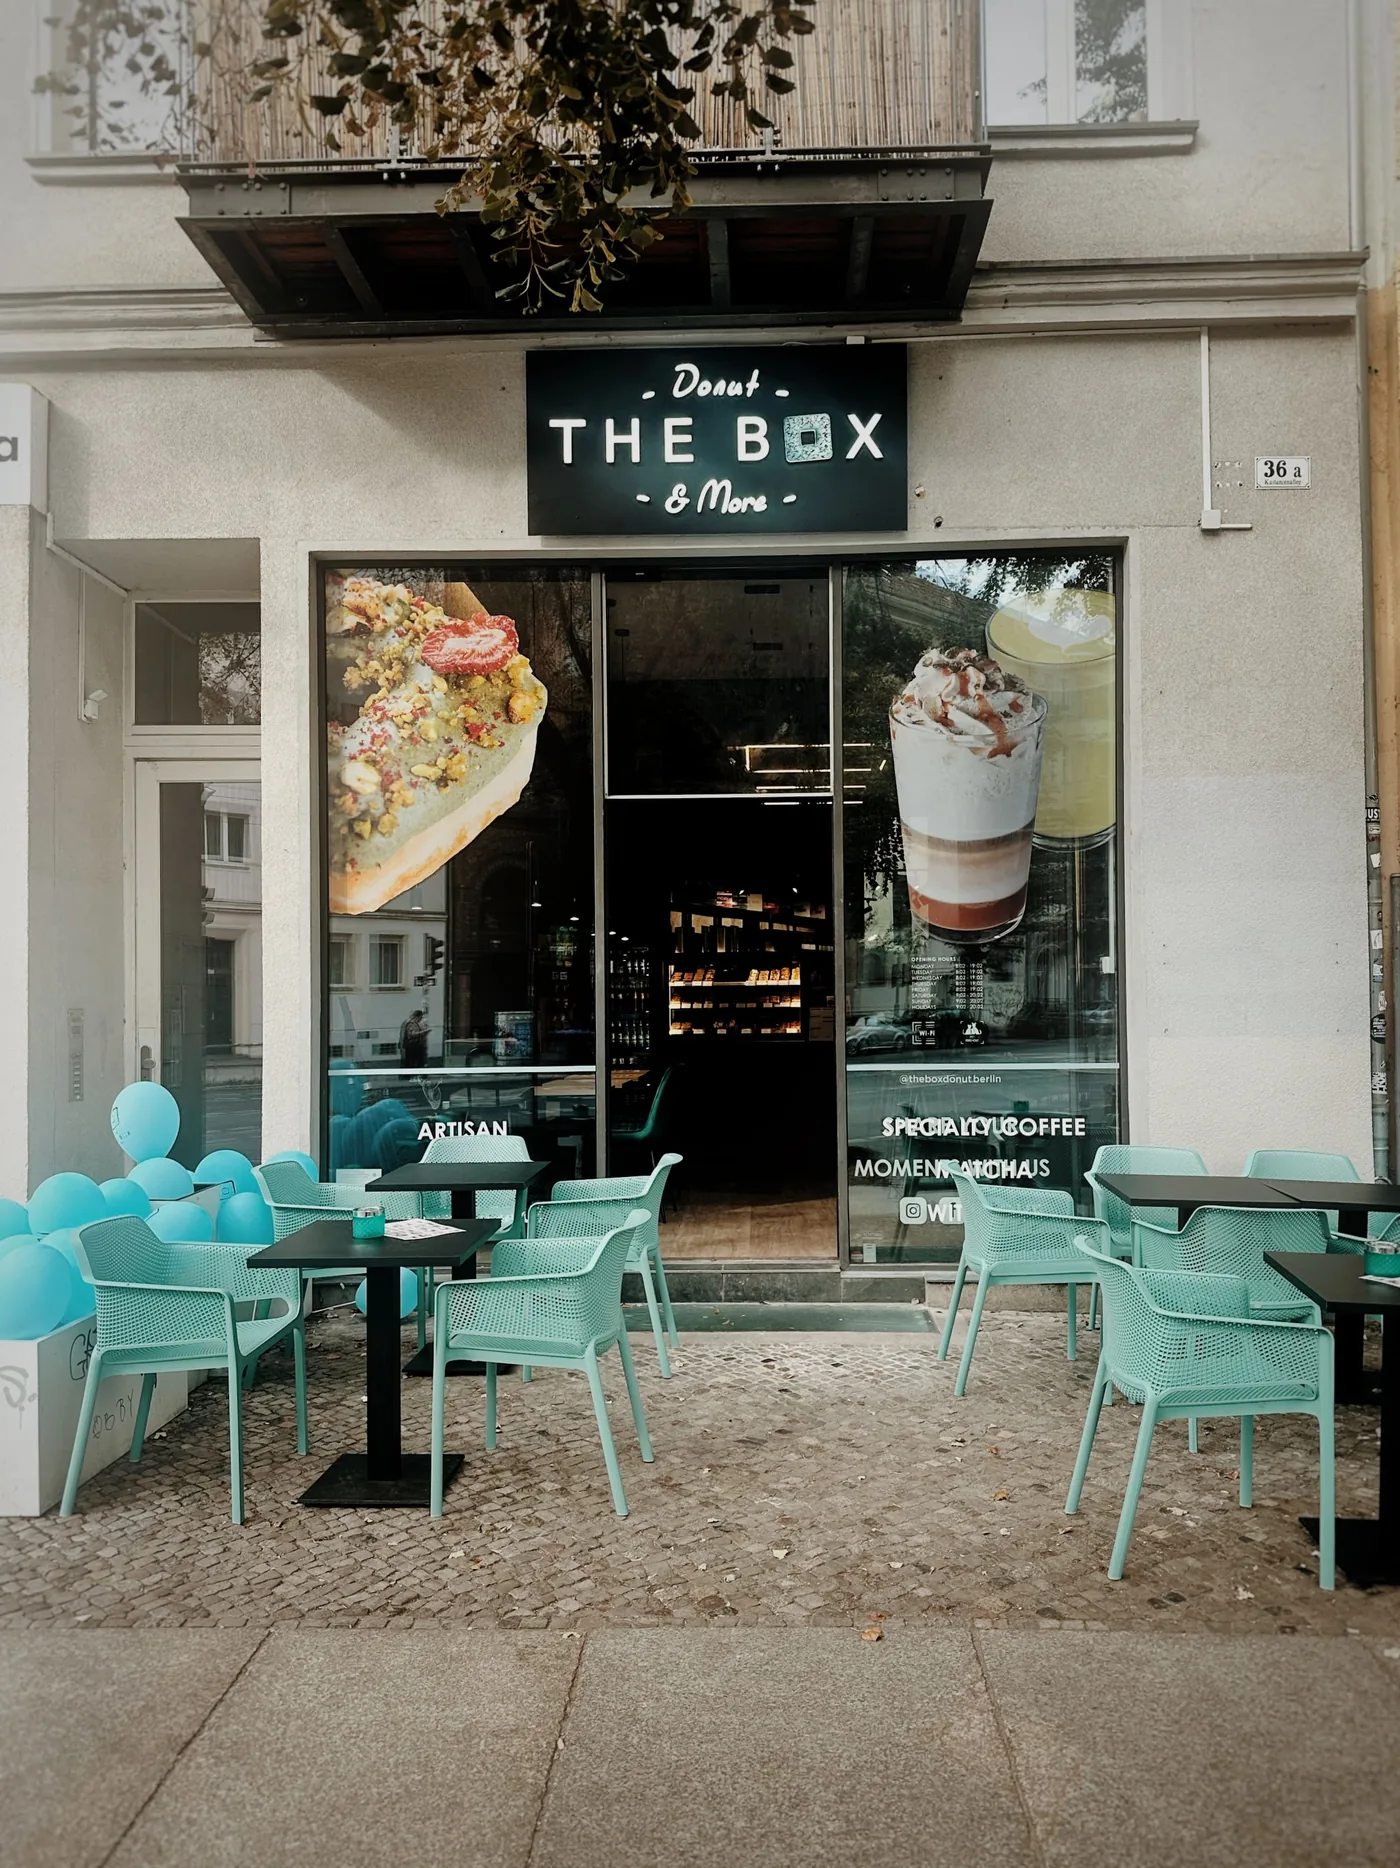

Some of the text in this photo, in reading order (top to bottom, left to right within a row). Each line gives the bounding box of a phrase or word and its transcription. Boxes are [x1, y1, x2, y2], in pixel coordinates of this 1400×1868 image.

[672, 362, 760, 399] Donut
[548, 416, 695, 465] THE
[1264, 460, 1302, 477] 36 a
[664, 479, 768, 515] & More
[417, 1120, 508, 1140] ARTISAN
[881, 1117, 1086, 1137] SPECIALTY COFFEE
[854, 1159, 959, 1177] MOMEN
